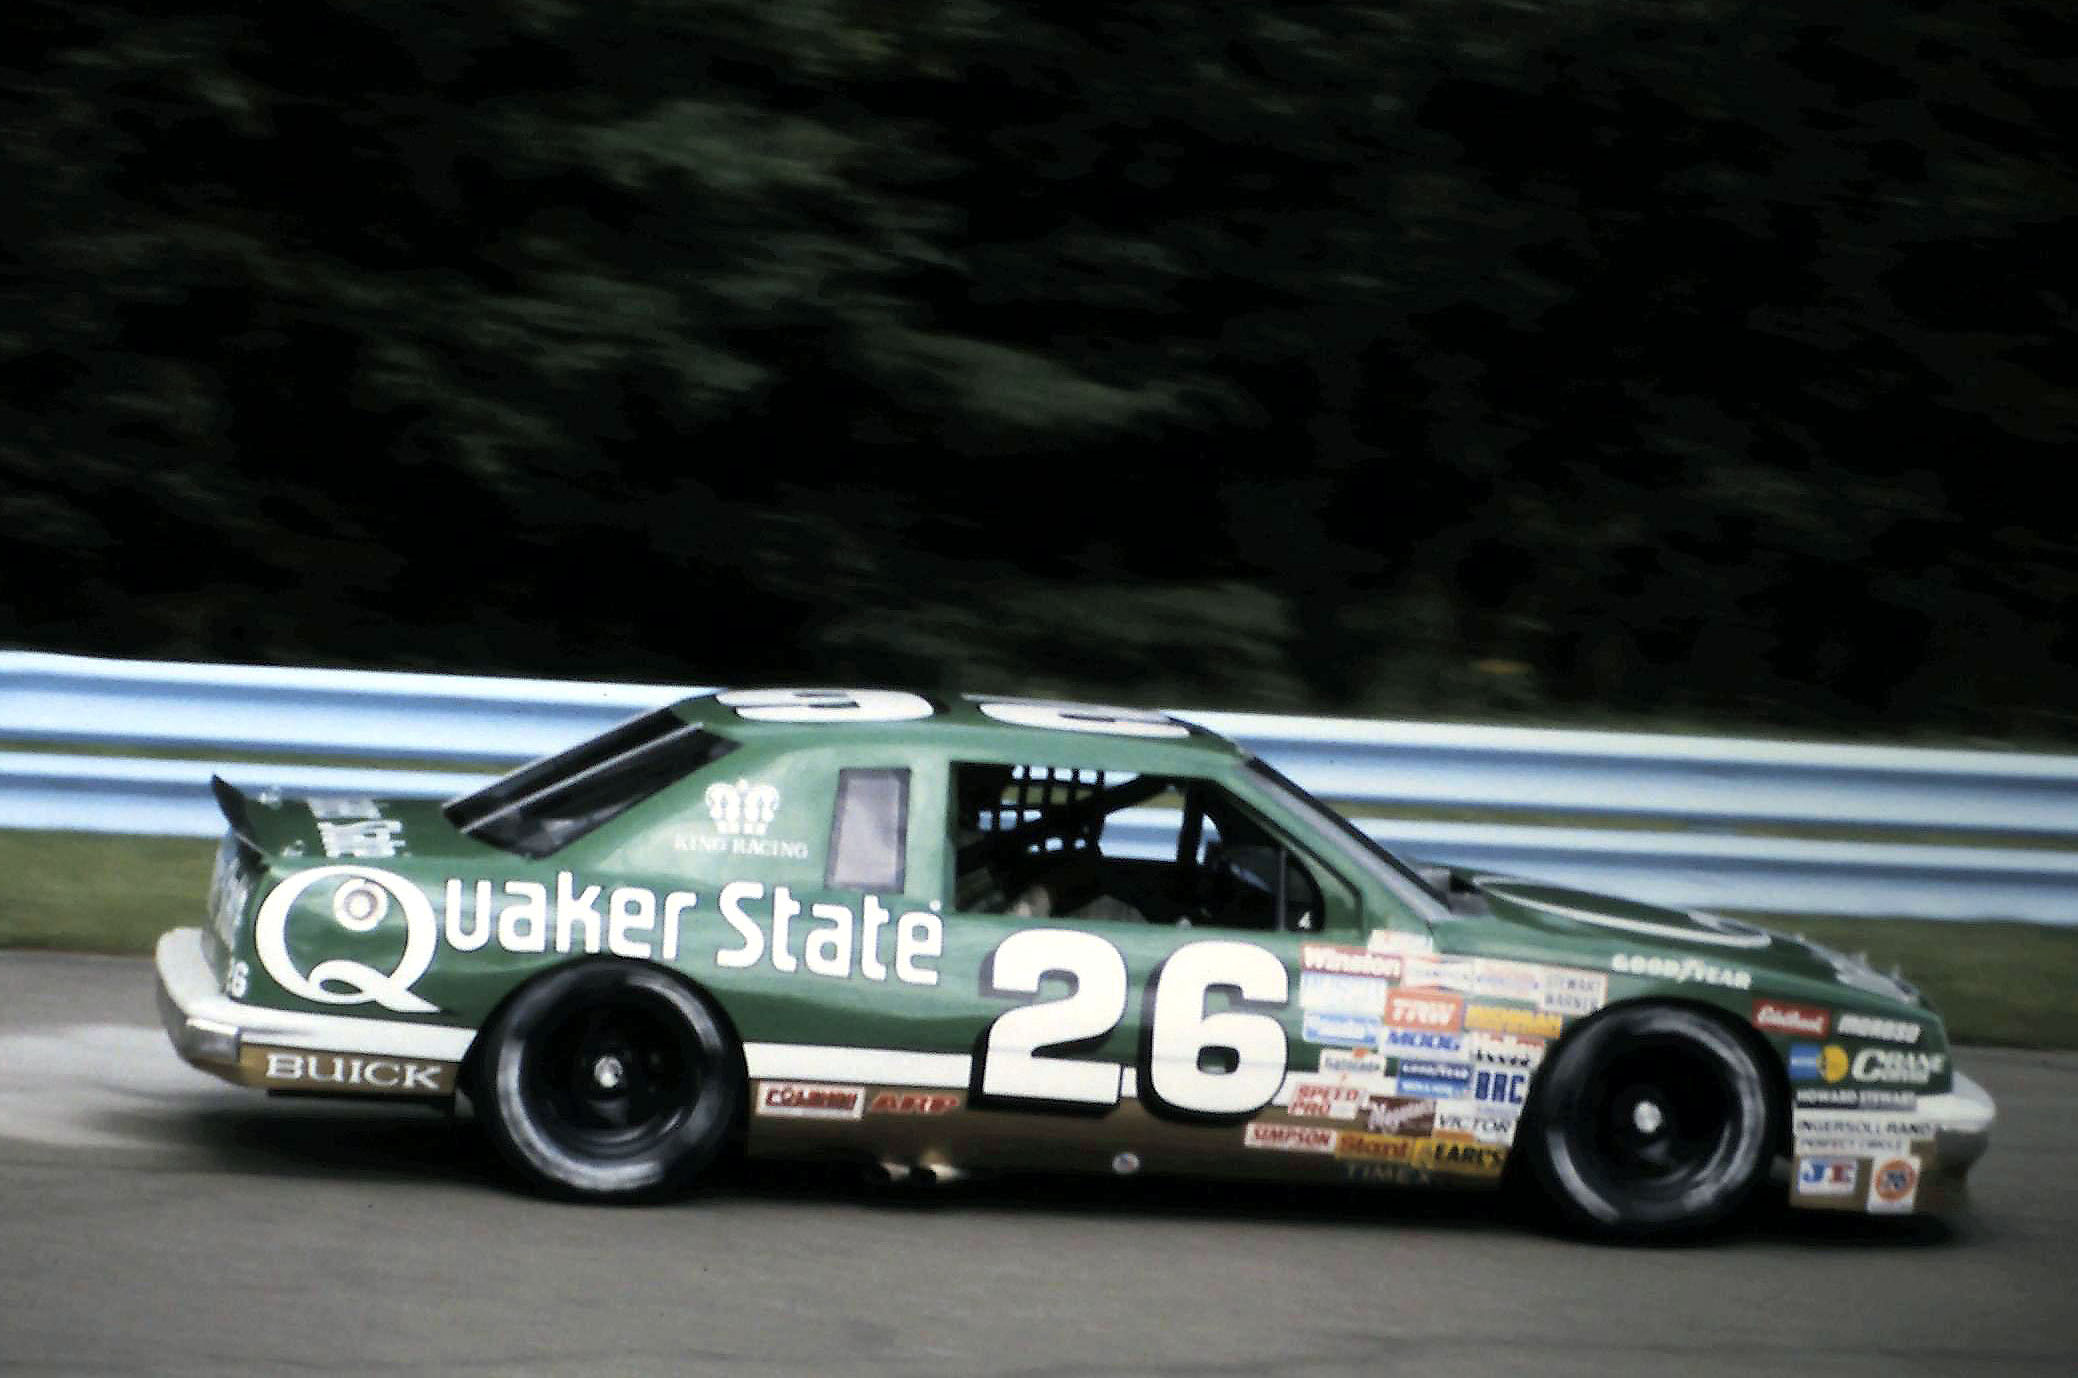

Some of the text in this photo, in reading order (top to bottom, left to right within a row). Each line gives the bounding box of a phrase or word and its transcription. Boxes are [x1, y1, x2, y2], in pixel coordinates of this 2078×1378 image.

[732, 838, 809, 860] RACING
[255, 865, 697, 1014] Quaker
[716, 880, 943, 986] State
[1611, 953, 1752, 989] GOODYEAR
[976, 926, 1290, 1118] 26
[1392, 998, 1457, 1026] TRW
[265, 1052, 444, 1091] BUICK
[1253, 1125, 1332, 1147] SIMPSON
